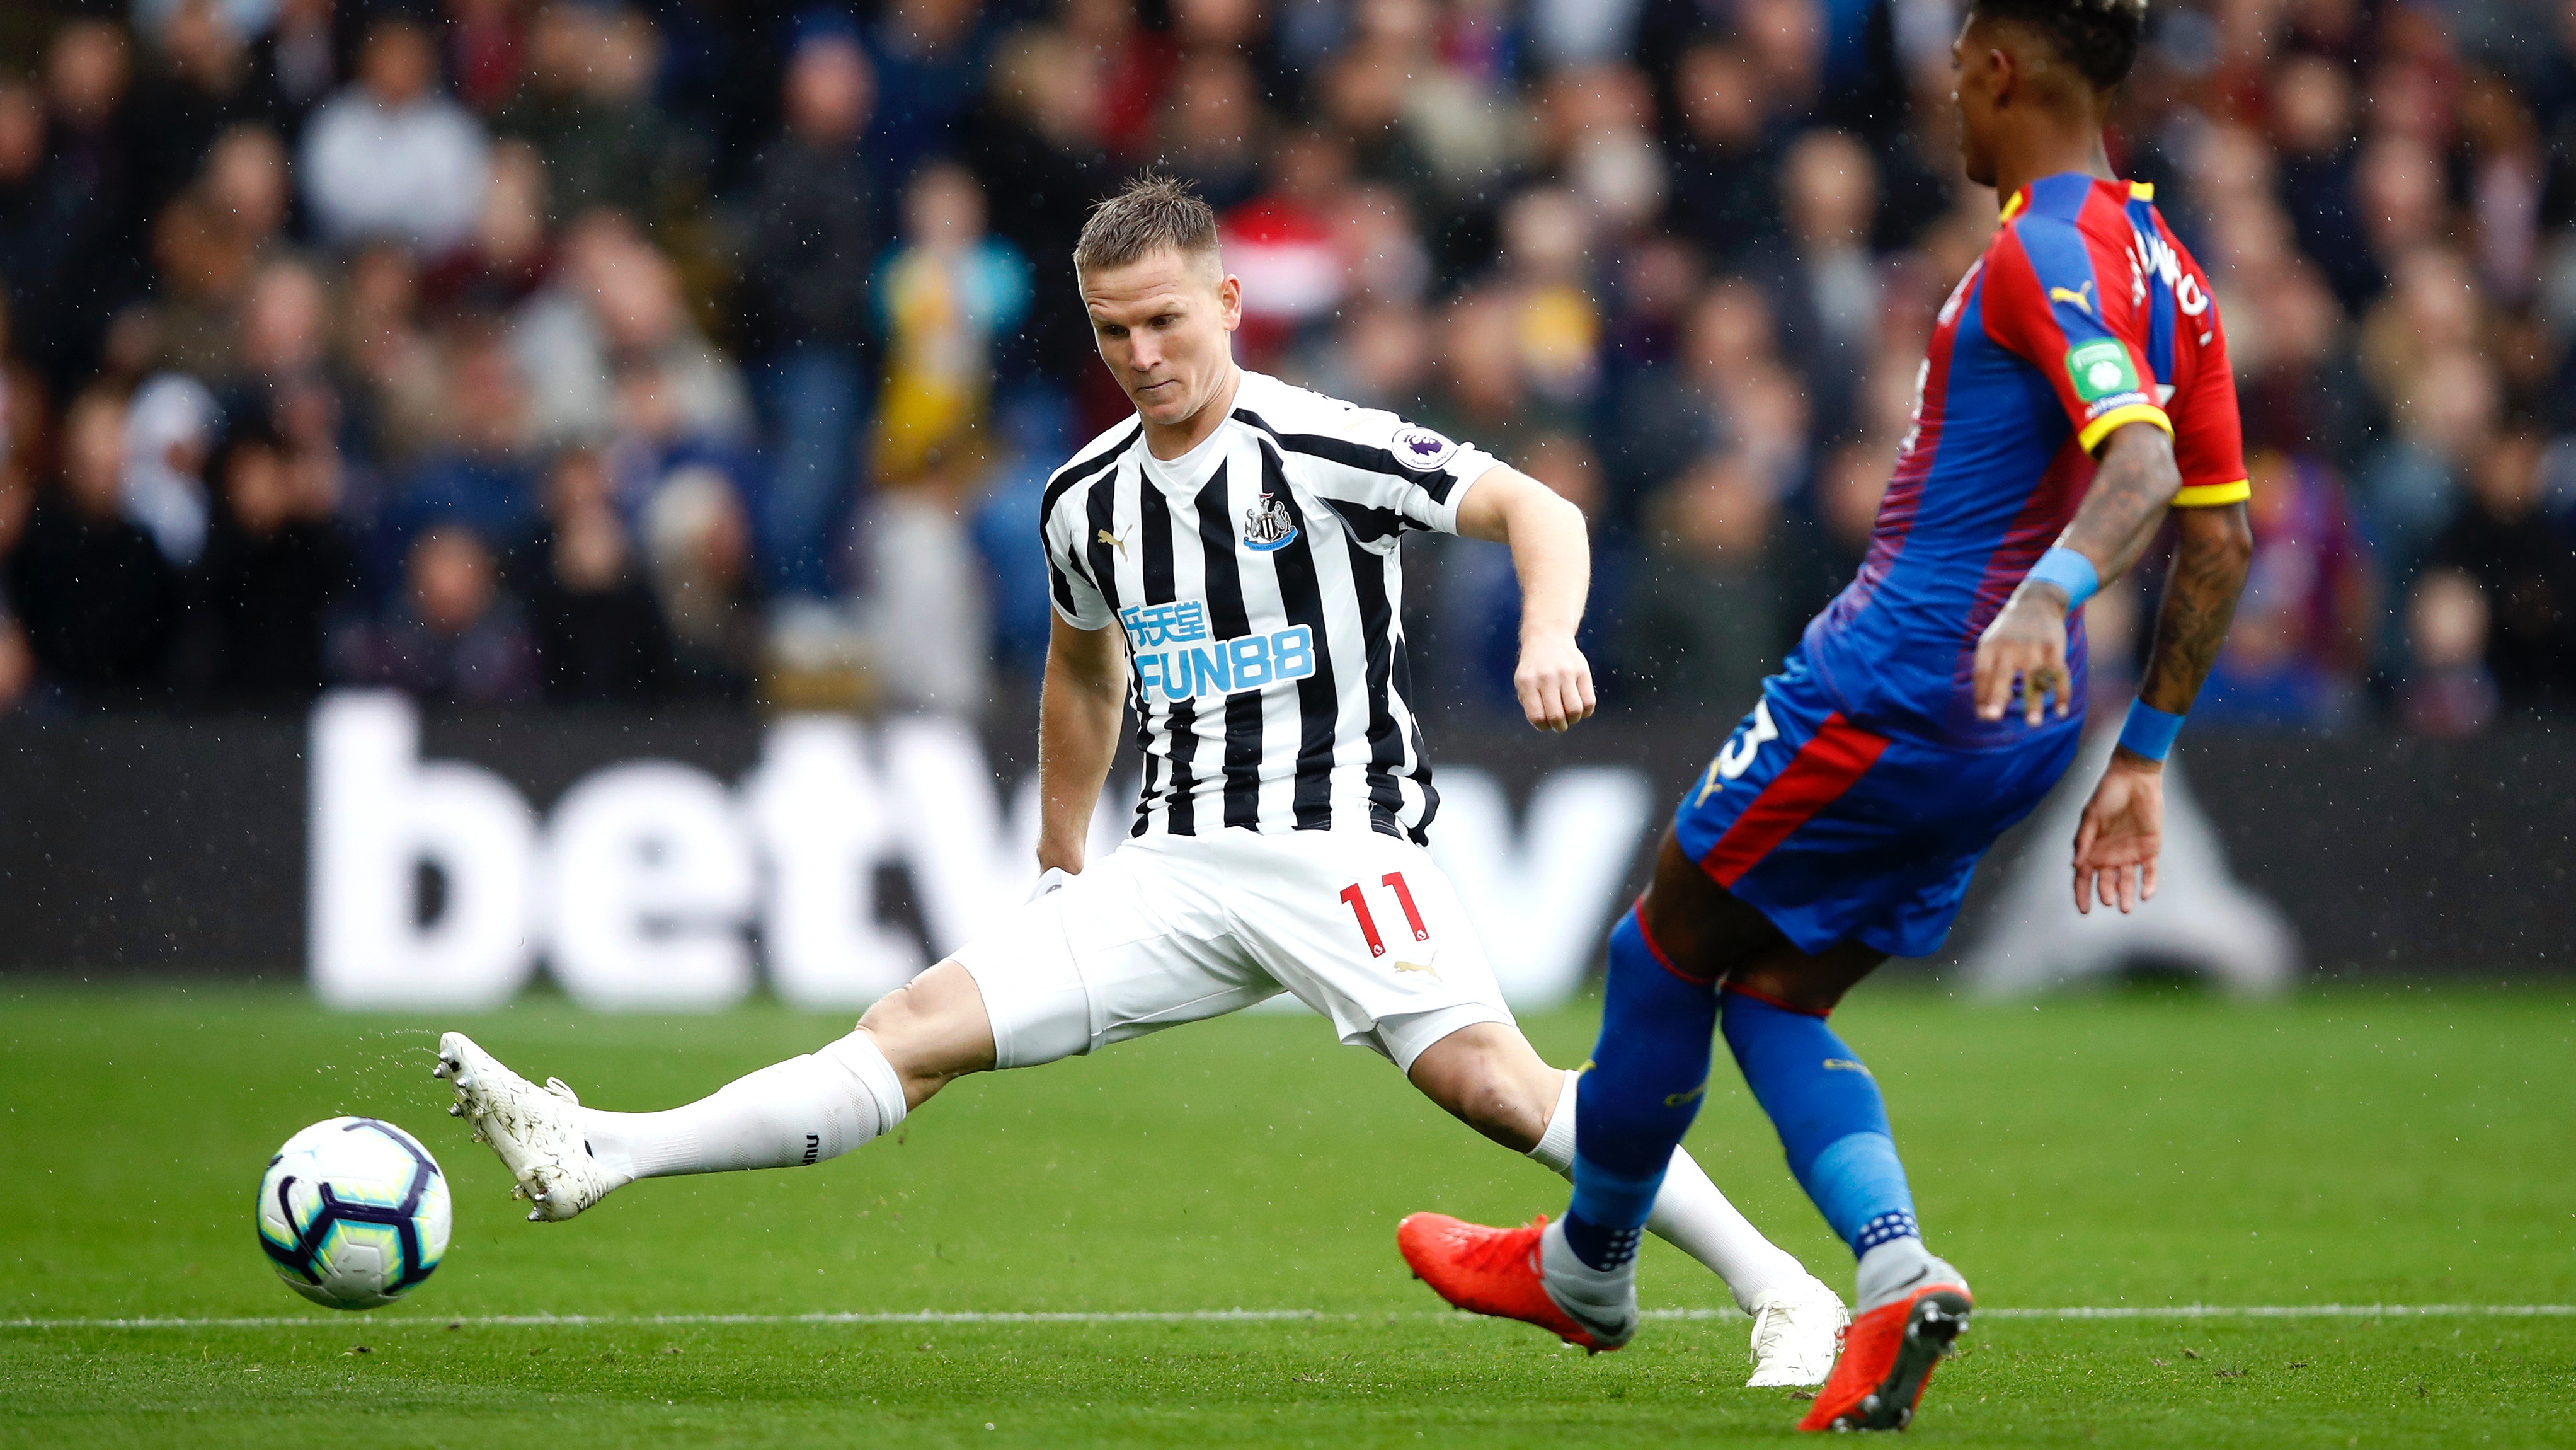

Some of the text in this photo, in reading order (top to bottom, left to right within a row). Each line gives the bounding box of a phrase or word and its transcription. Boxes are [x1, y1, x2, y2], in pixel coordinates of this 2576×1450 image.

[1121, 600, 1207, 647] 乐天堂
[1135, 627, 1313, 701] FUN88
[1720, 698, 1778, 779] 3
[1339, 871, 1429, 958] 11
